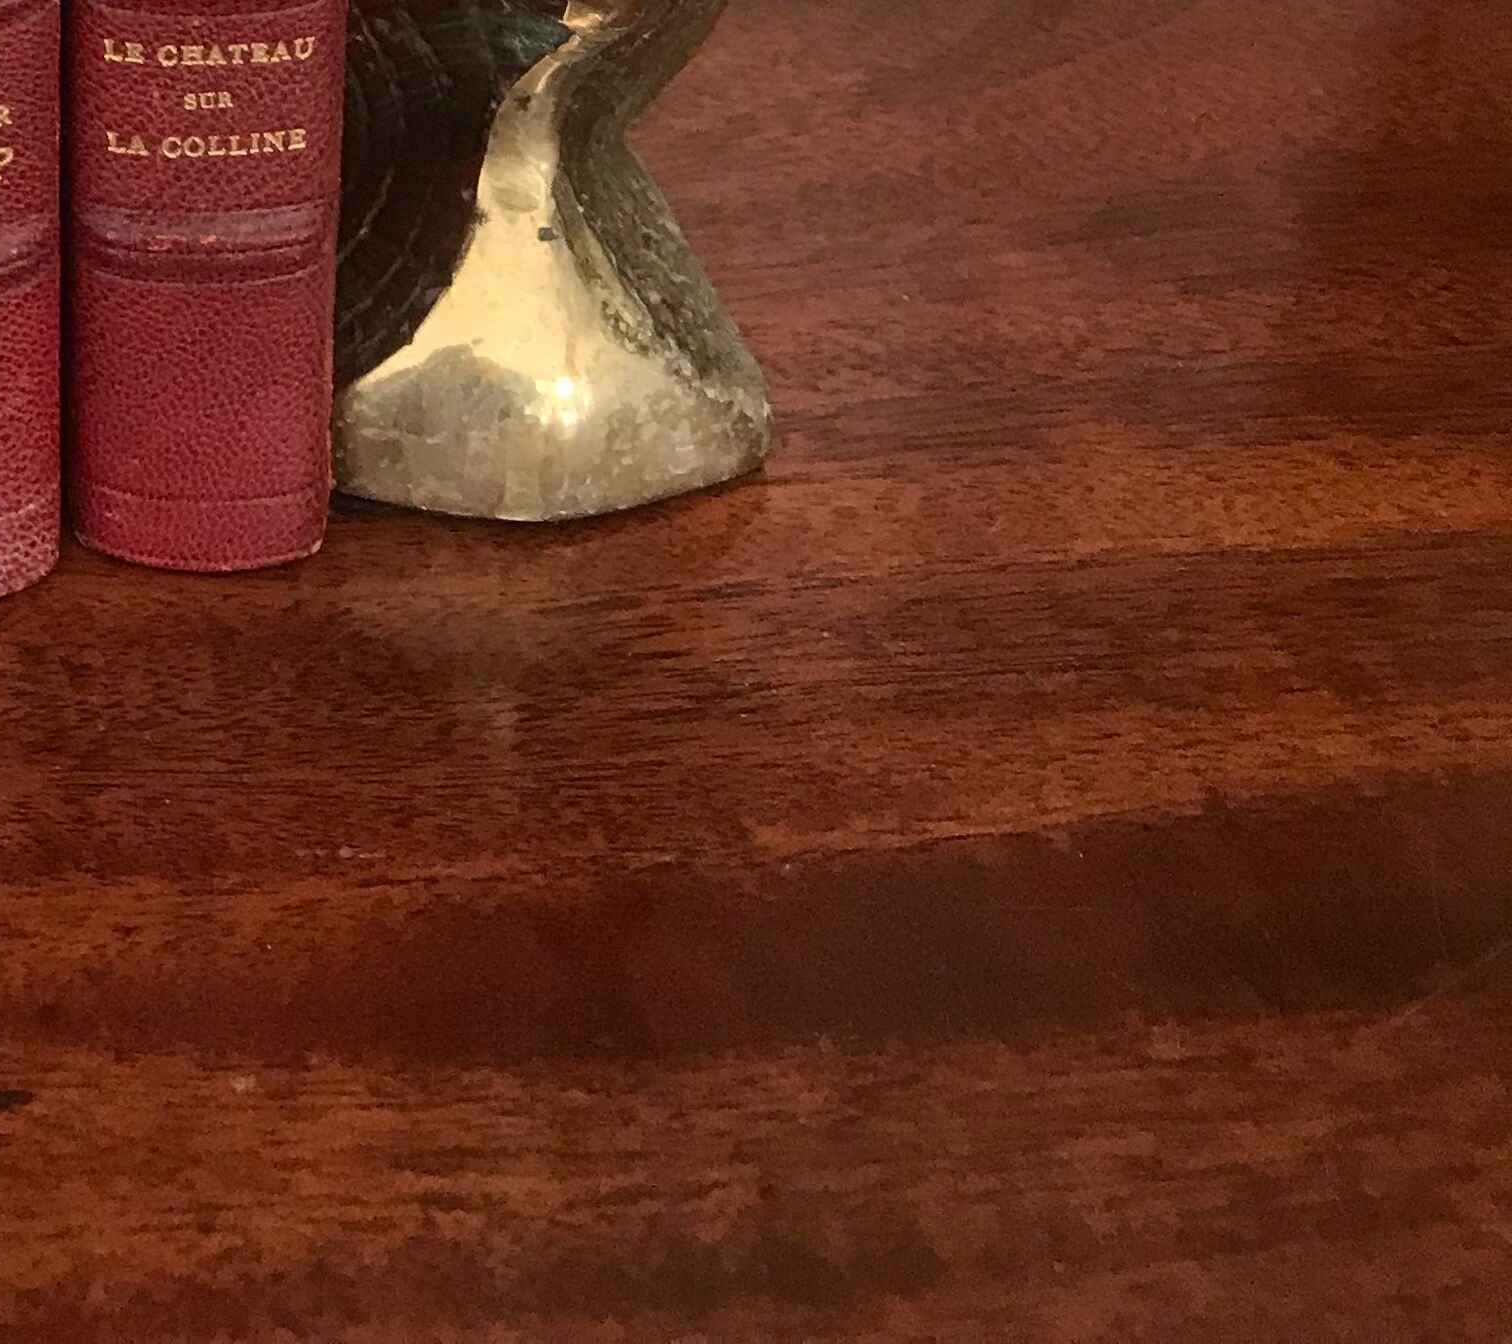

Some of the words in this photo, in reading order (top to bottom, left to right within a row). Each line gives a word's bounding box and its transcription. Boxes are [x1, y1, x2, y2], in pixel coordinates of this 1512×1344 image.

[103, 38, 144, 64] LE
[160, 37, 316, 68] CHATEAU
[183, 91, 234, 111] SUR
[105, 130, 148, 156] LA
[162, 128, 307, 159] COLLINE
